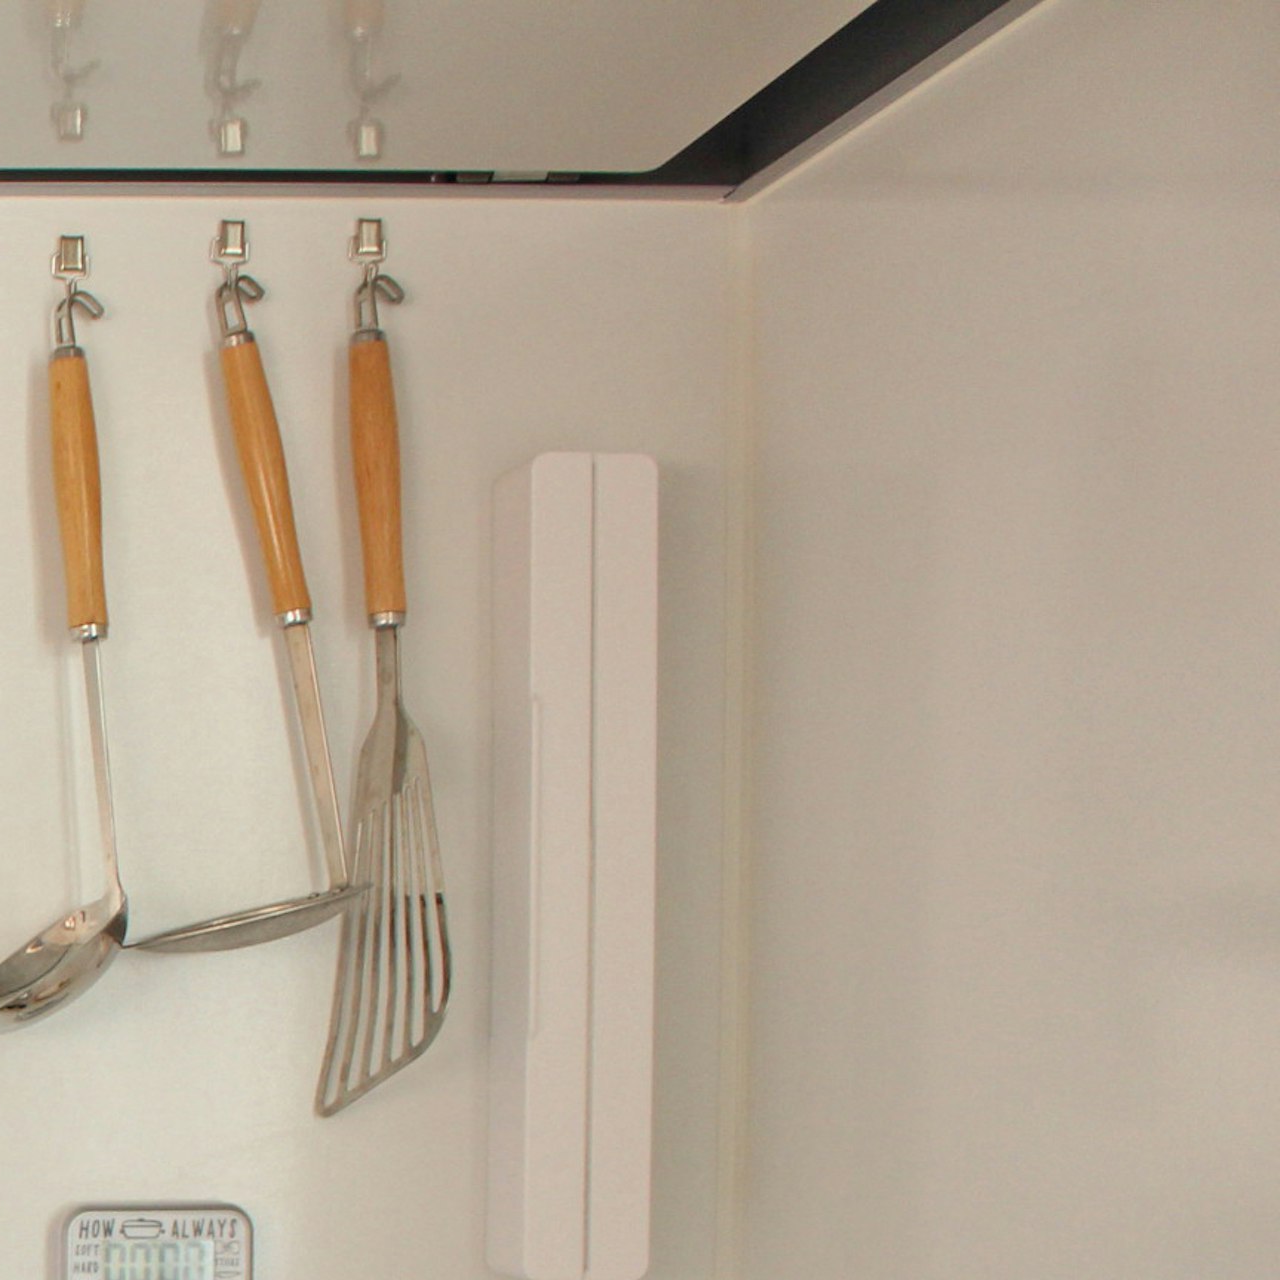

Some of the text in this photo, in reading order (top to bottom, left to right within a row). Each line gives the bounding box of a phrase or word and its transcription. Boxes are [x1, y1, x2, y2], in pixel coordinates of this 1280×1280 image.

[78, 1218, 238, 1239] HOW ALWAYS
[73, 1261, 100, 1274] HARD
